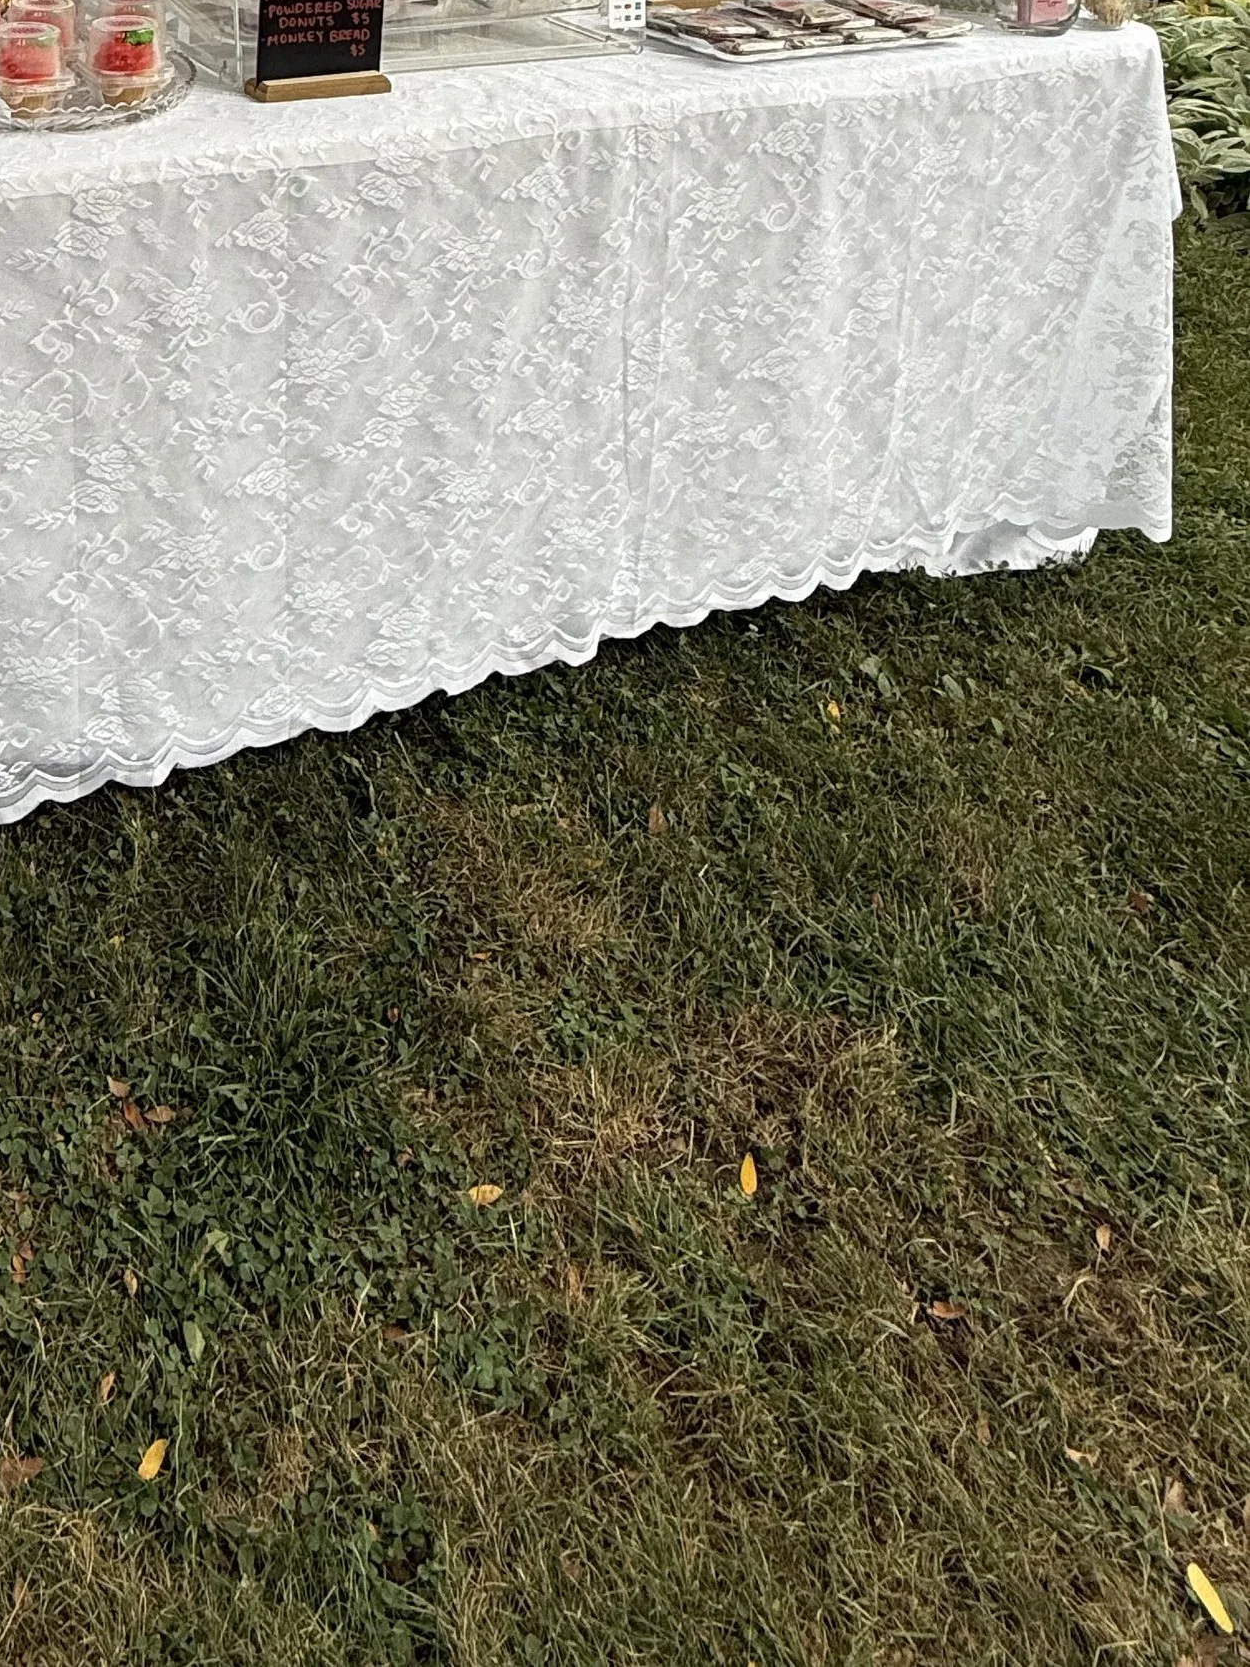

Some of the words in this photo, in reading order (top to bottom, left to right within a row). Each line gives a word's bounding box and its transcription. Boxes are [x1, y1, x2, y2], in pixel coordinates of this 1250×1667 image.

[268, 1, 342, 18] POWDERED
[279, 16, 335, 29] DONUTS
[351, 12, 370, 25] $5
[267, 31, 324, 46] MONKEY
[330, 29, 370, 43] BREAD
[350, 44, 365, 56] $5
